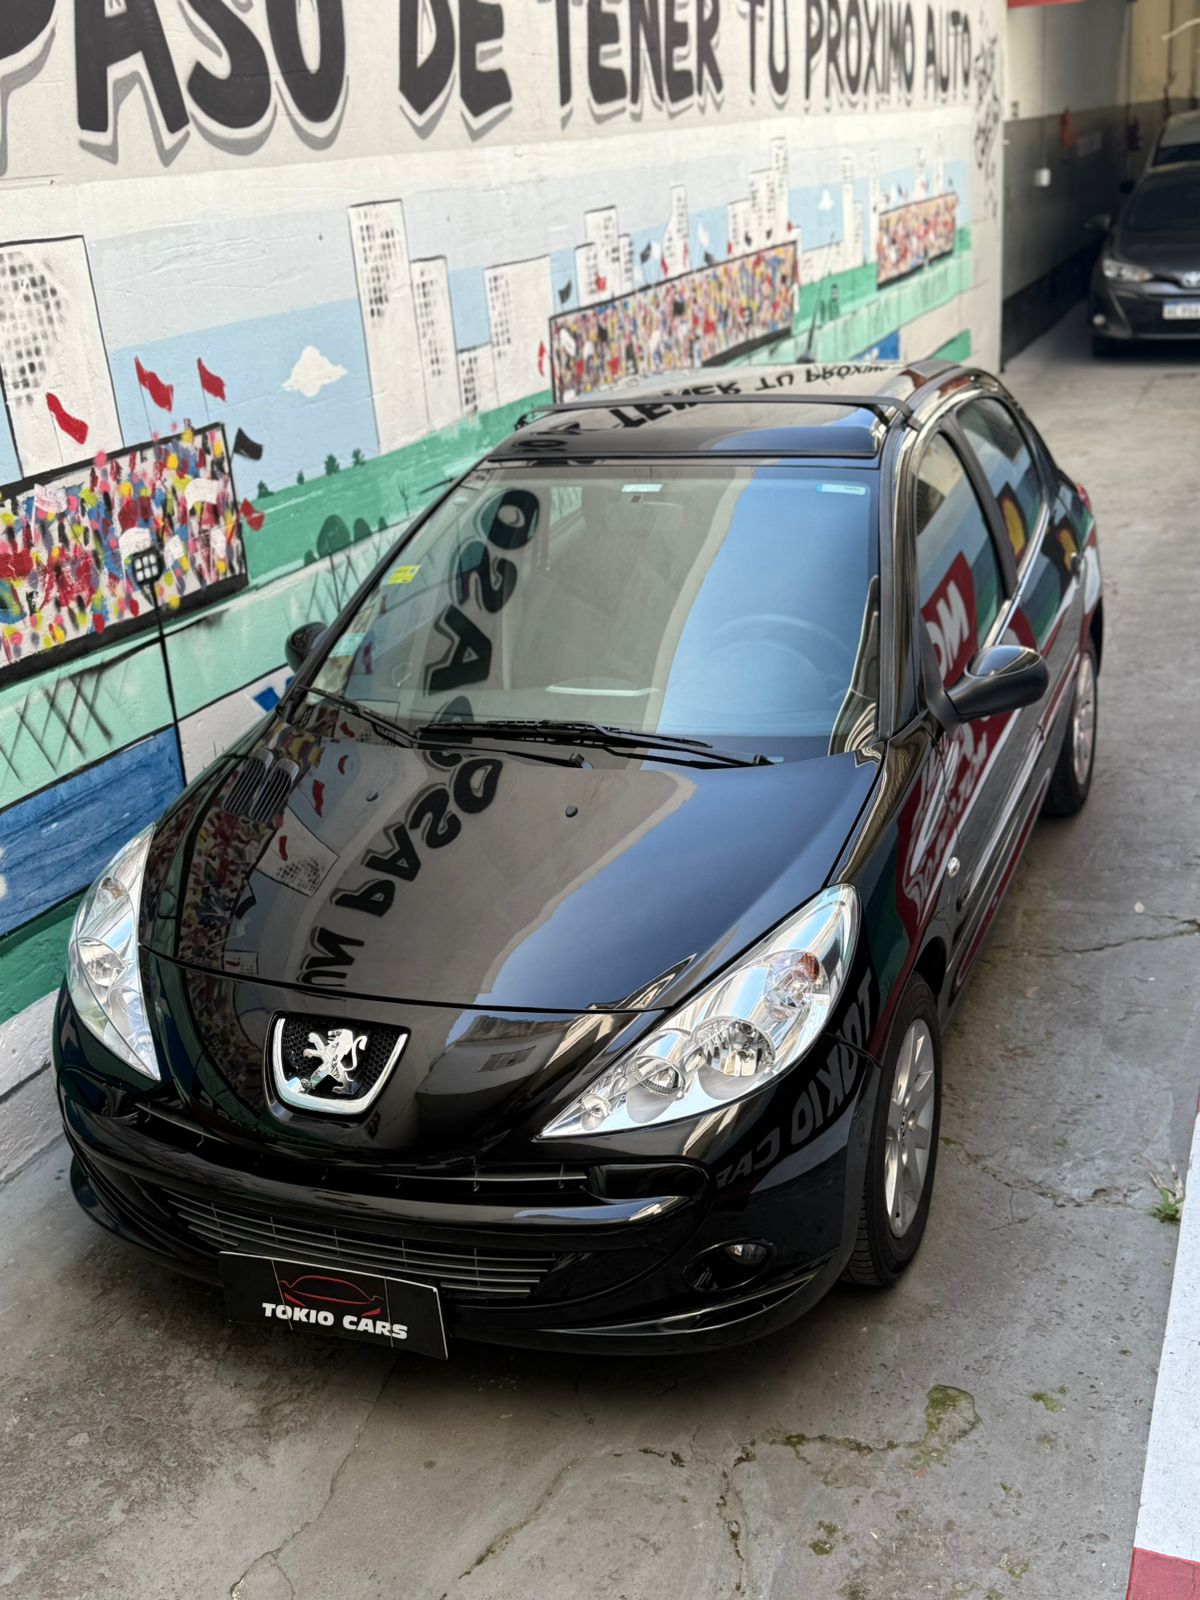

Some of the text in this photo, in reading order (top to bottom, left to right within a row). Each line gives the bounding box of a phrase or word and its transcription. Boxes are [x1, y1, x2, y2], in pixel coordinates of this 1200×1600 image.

[398, 0, 512, 119] DE
[742, 0, 790, 97] TU
[925, 1, 971, 98] AUTO
[262, 1302, 408, 1339] TOKIO CARS
